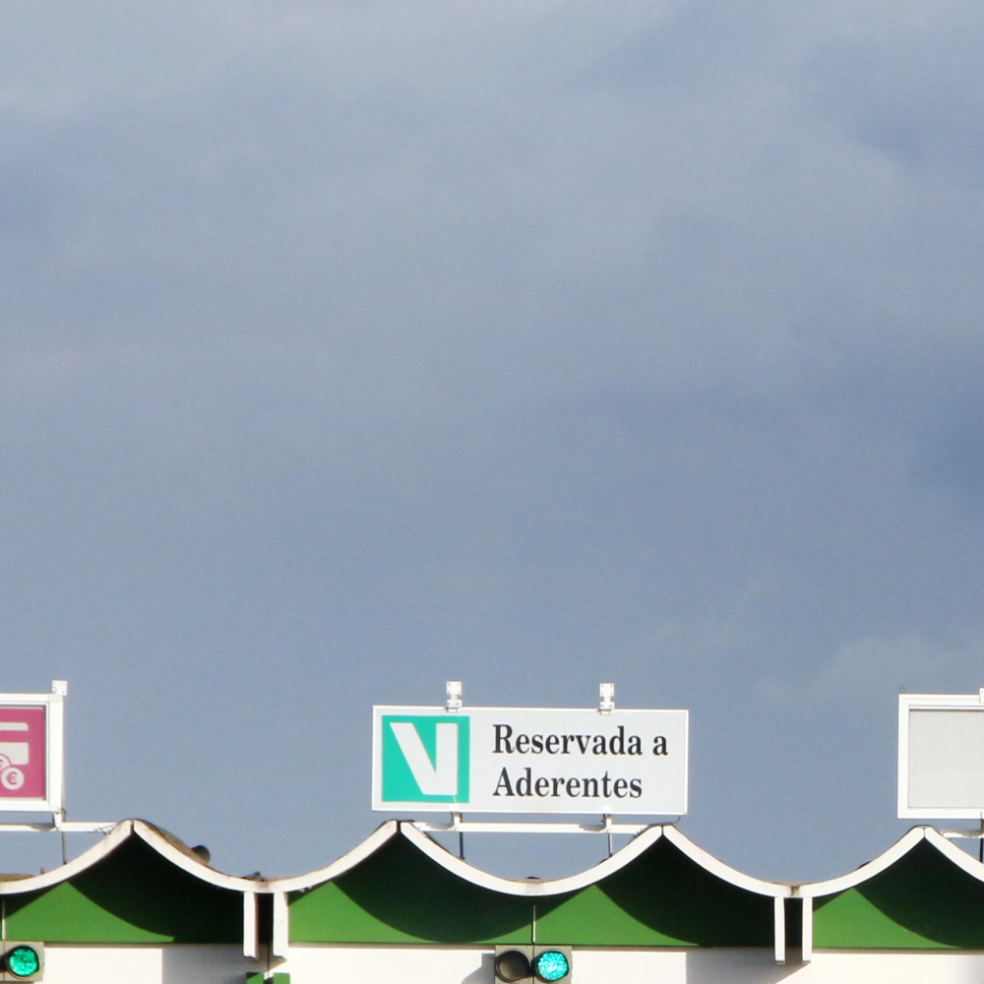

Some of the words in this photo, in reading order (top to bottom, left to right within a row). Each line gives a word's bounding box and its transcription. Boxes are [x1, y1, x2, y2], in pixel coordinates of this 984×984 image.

[492, 724, 643, 755] Reservada
[652, 735, 669, 755] a
[492, 767, 642, 798] Aderentes
